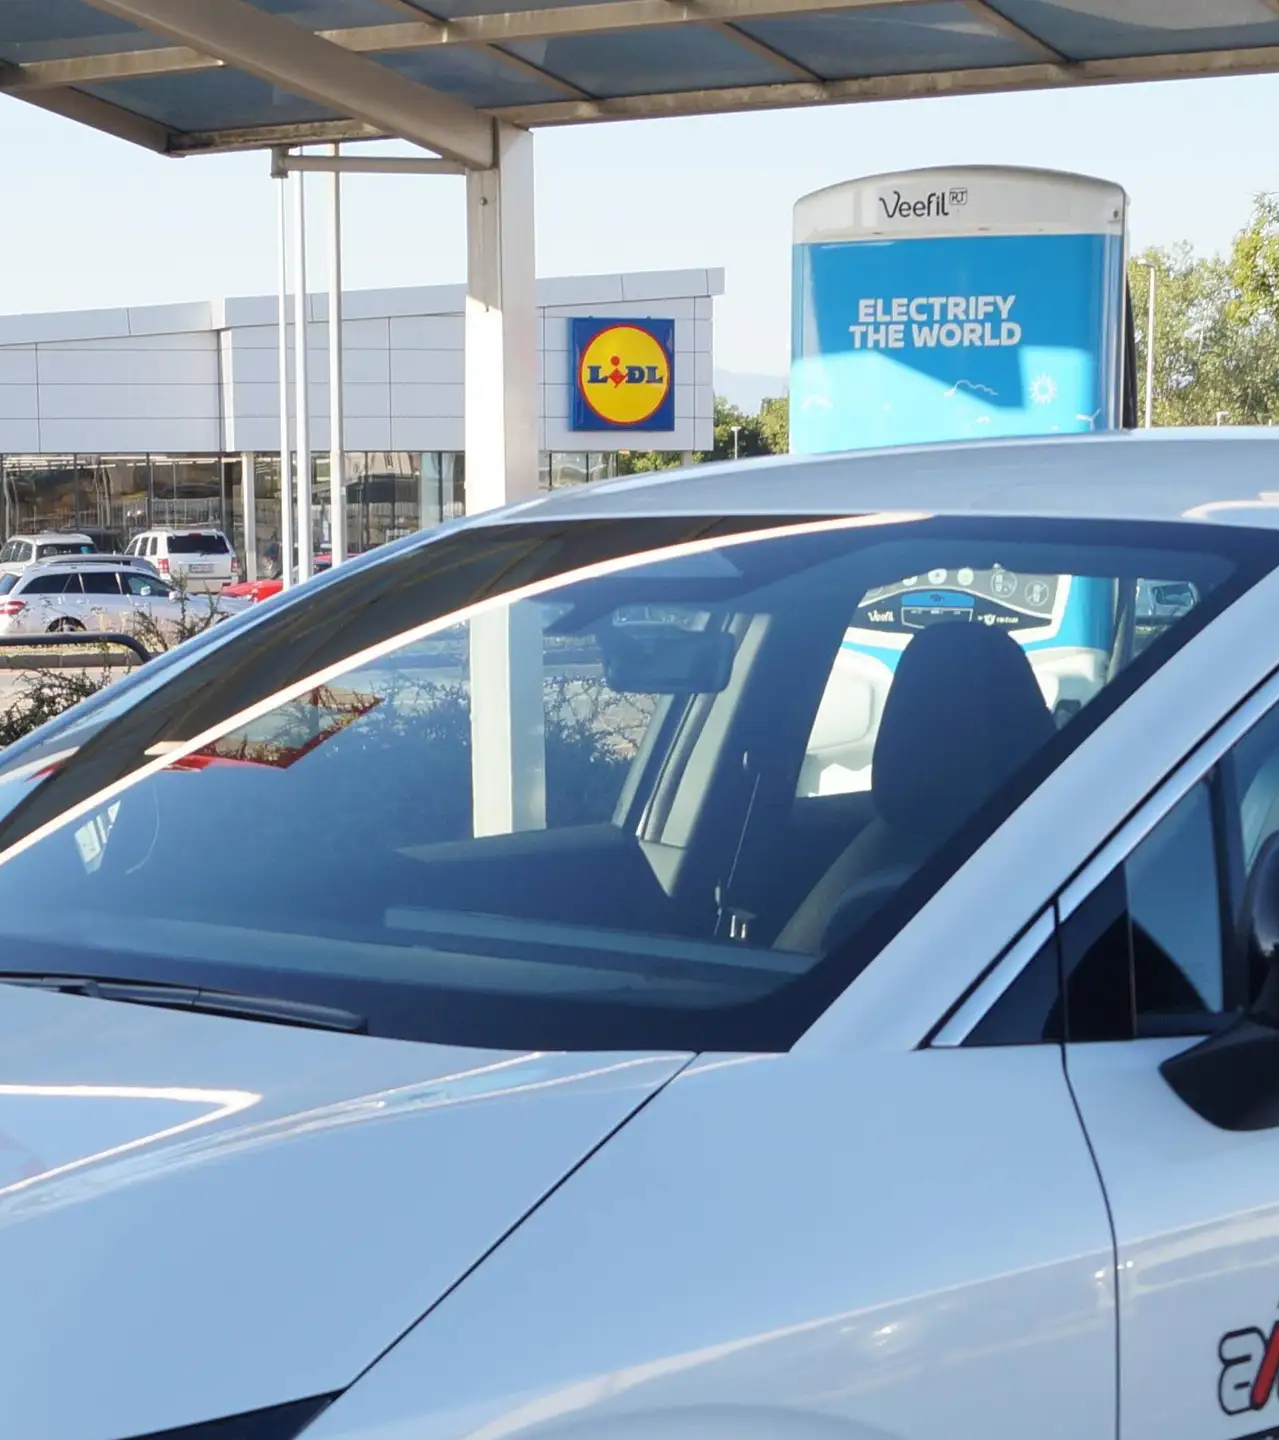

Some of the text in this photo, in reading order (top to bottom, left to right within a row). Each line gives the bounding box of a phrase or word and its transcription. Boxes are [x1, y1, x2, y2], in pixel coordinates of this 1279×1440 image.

[878, 190, 949, 219] Veefil
[858, 295, 1016, 323] ELECTRIFY
[849, 322, 1022, 349] THE WORLD
